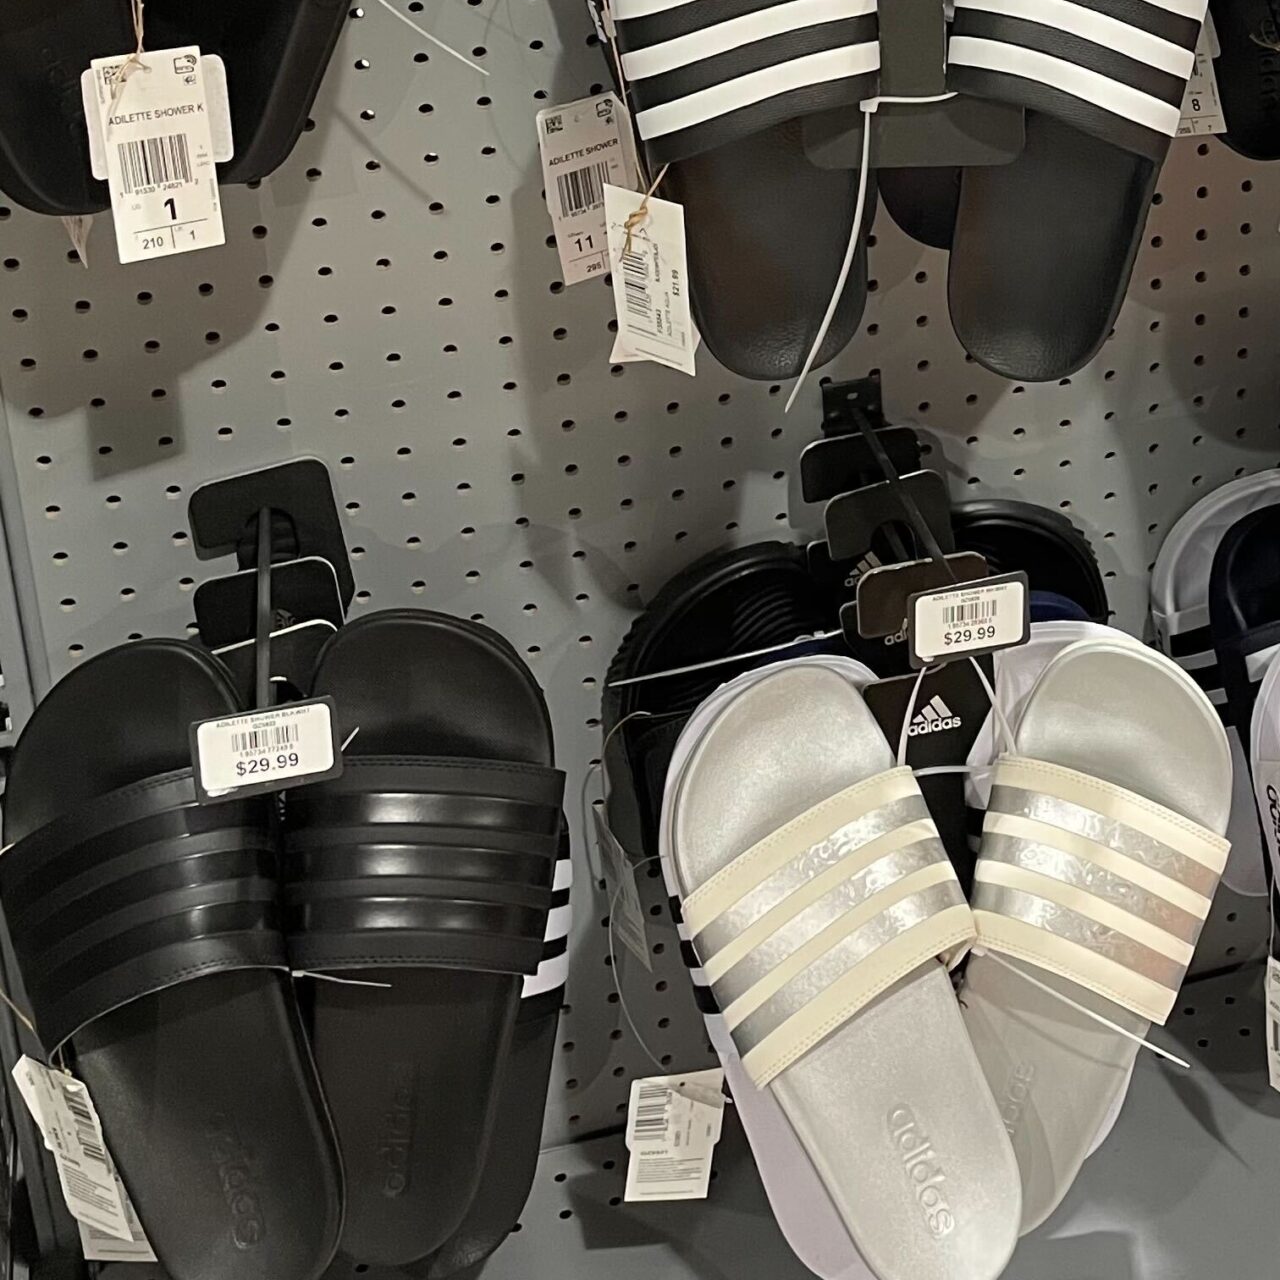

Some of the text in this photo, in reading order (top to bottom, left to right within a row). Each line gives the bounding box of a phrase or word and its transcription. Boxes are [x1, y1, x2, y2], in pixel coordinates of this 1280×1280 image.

[108, 103, 204, 126] ADILETTE SHOWER K
[1191, 98, 1201, 111] 8
[548, 138, 619, 167] ADILETTE SHOWER
[163, 197, 177, 221] 1
[142, 236, 164, 250] 210
[189, 229, 196, 240] 1
[574, 235, 594, 252] 11
[944, 625, 995, 646] $29.99
[907, 716, 962, 736] adidas
[236, 752, 299, 776] $29.99
[886, 1102, 956, 1241] adidas
